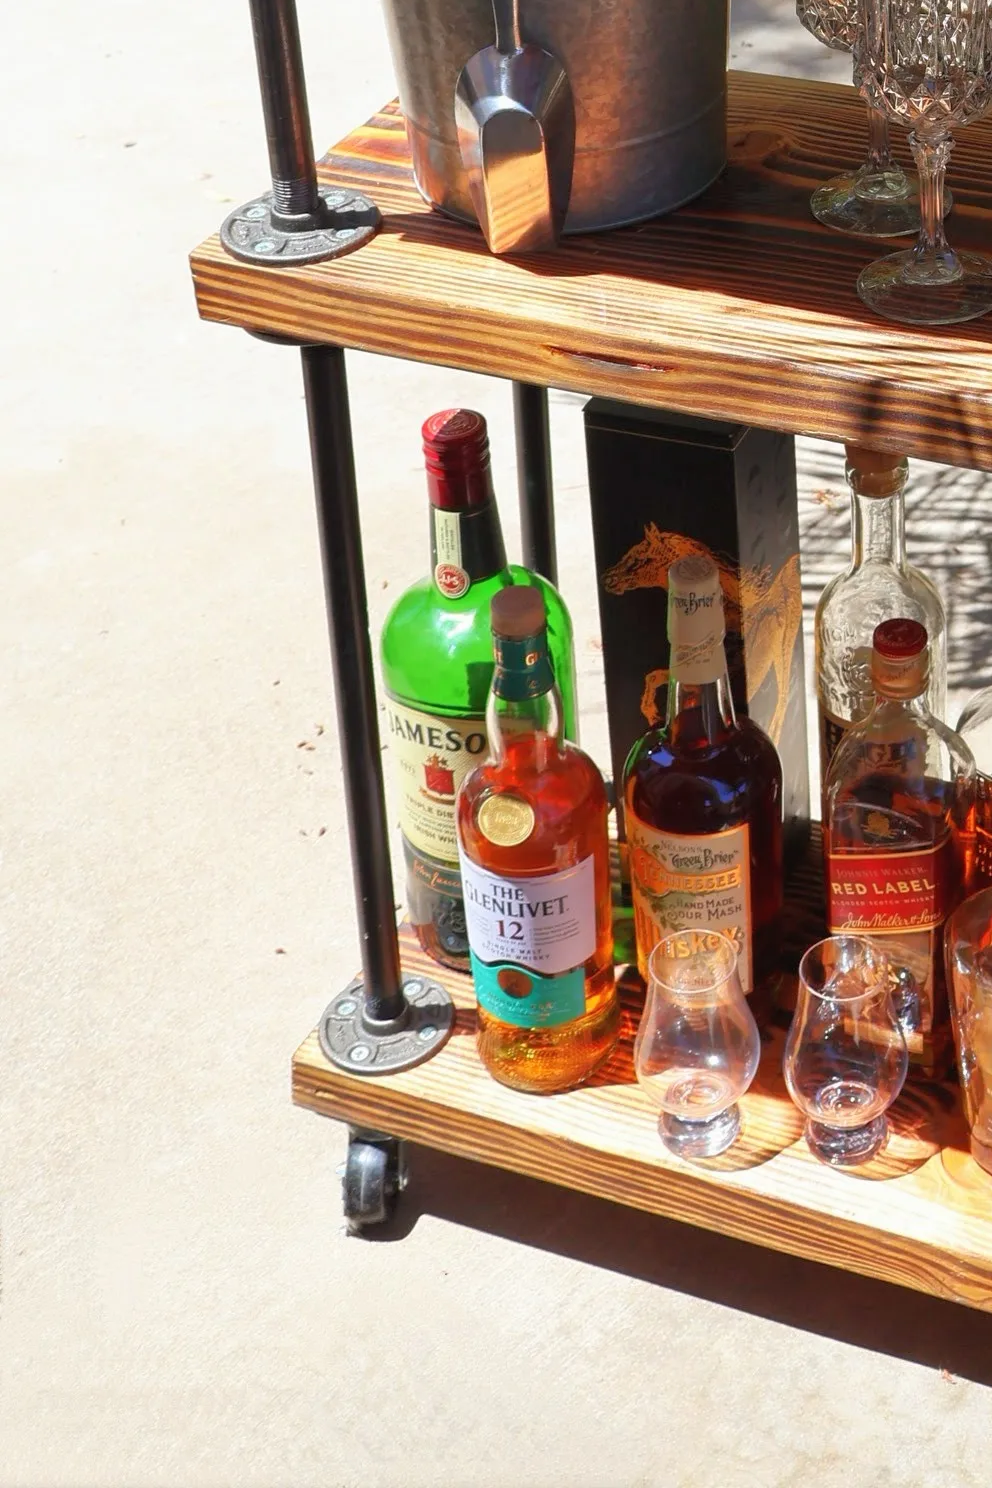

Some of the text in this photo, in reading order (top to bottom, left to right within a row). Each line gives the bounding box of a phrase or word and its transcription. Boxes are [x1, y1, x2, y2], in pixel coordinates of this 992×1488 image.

[388, 710, 486, 755] JAMESO
[490, 883, 524, 900] THE
[832, 878, 935, 895] RED LABEL
[465, 880, 568, 918] GLENLIVET
[706, 897, 734, 909] MADE
[707, 904, 742, 922] MASH
[495, 920, 524, 941] 12
